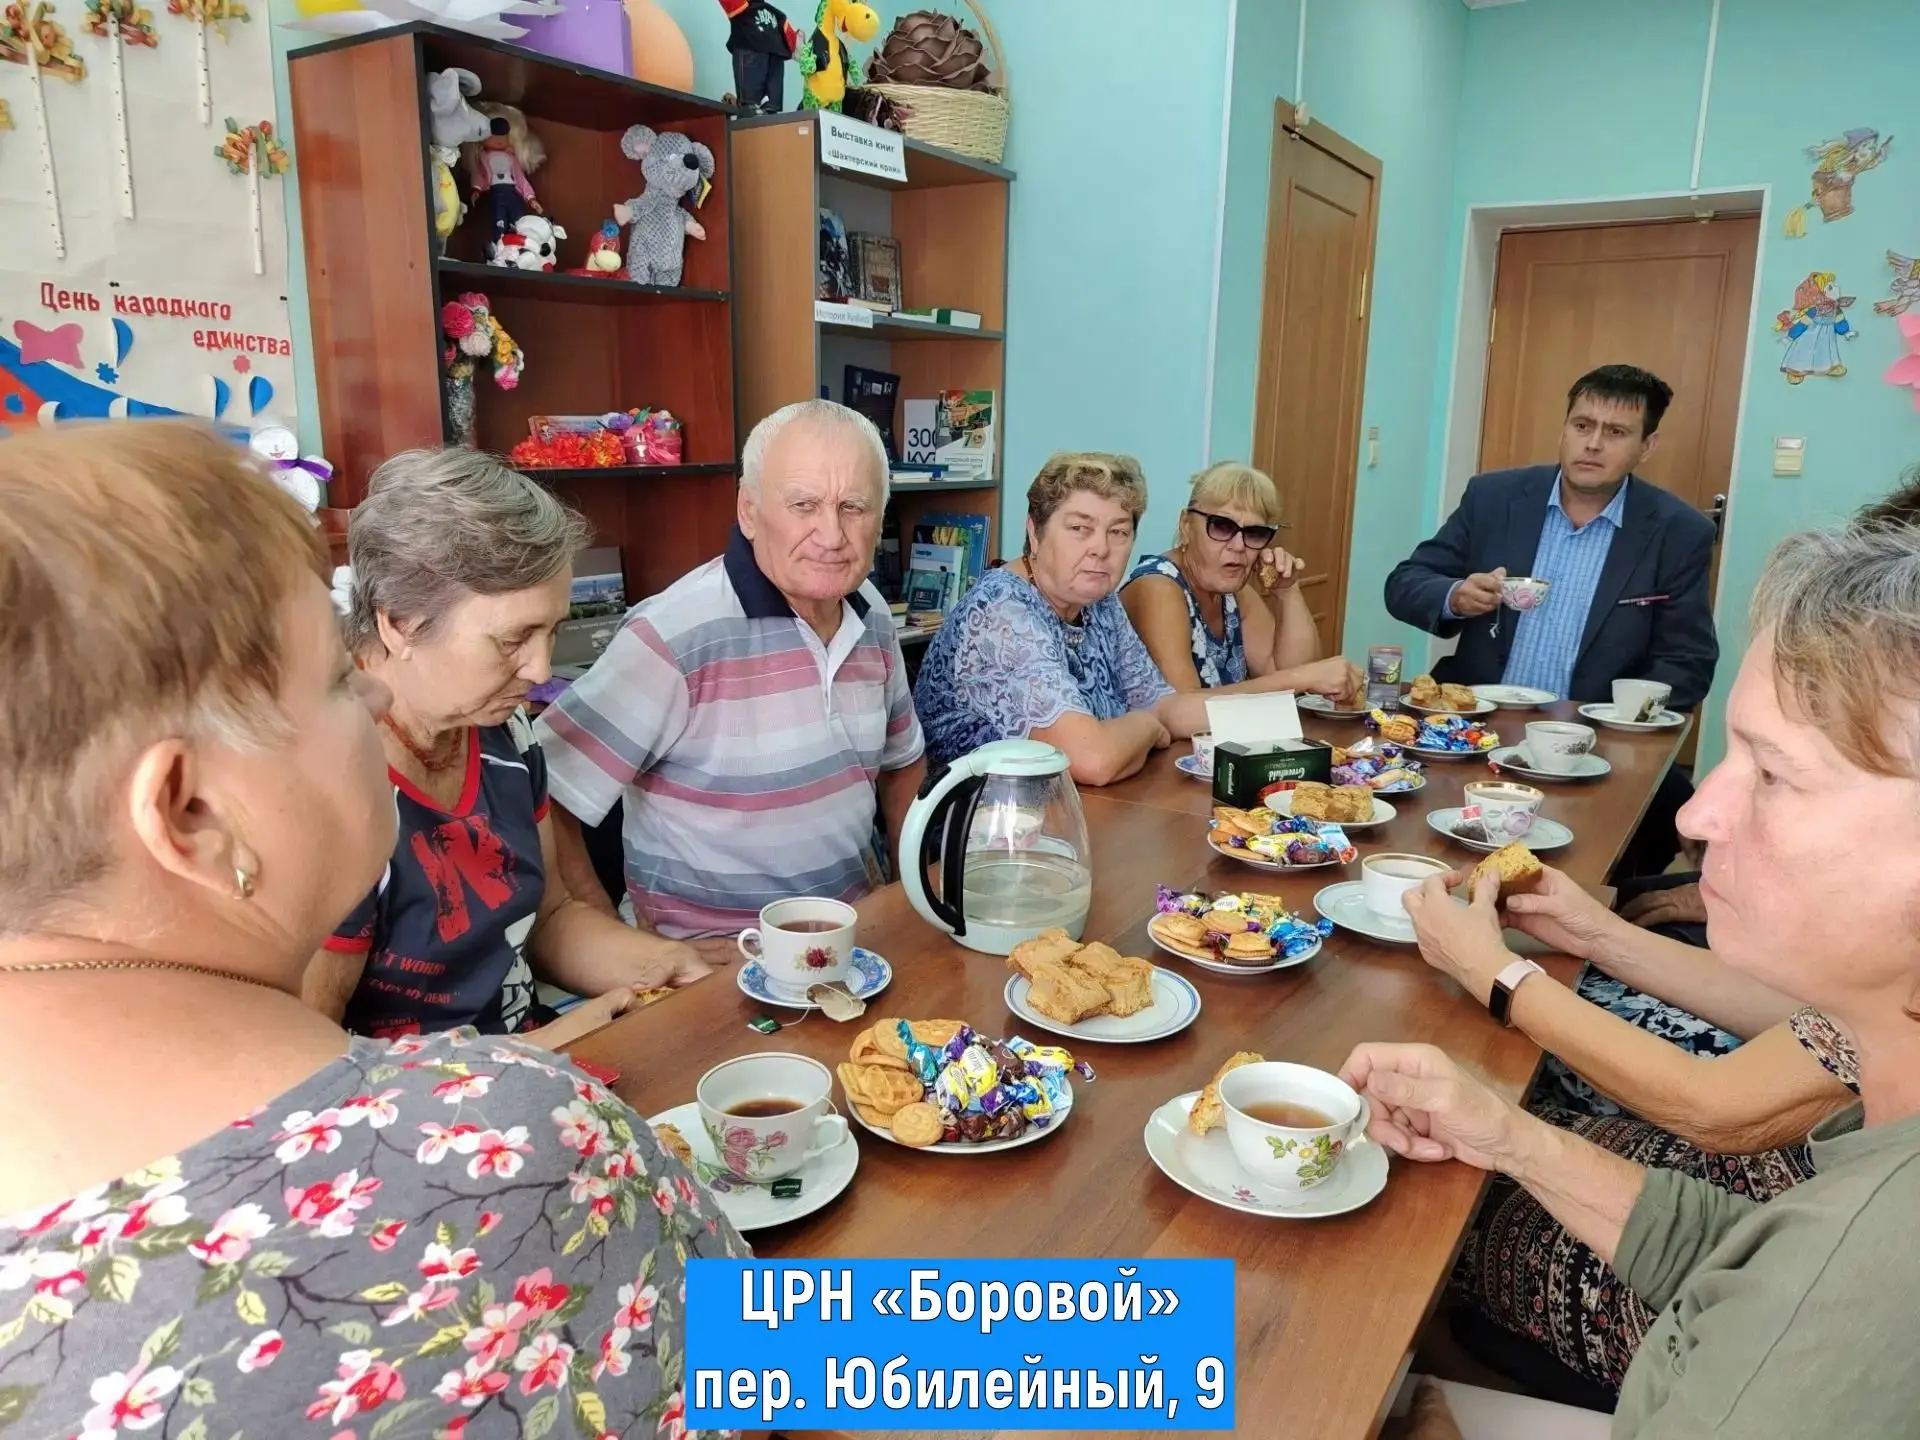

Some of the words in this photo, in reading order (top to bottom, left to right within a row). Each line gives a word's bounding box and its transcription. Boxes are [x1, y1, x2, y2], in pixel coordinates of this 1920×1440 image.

[831, 126, 873, 147] Выставка
[875, 142, 895, 153] книг
[40, 282, 101, 313] День
[113, 294, 232, 321] народного
[193, 330, 291, 356] единства
